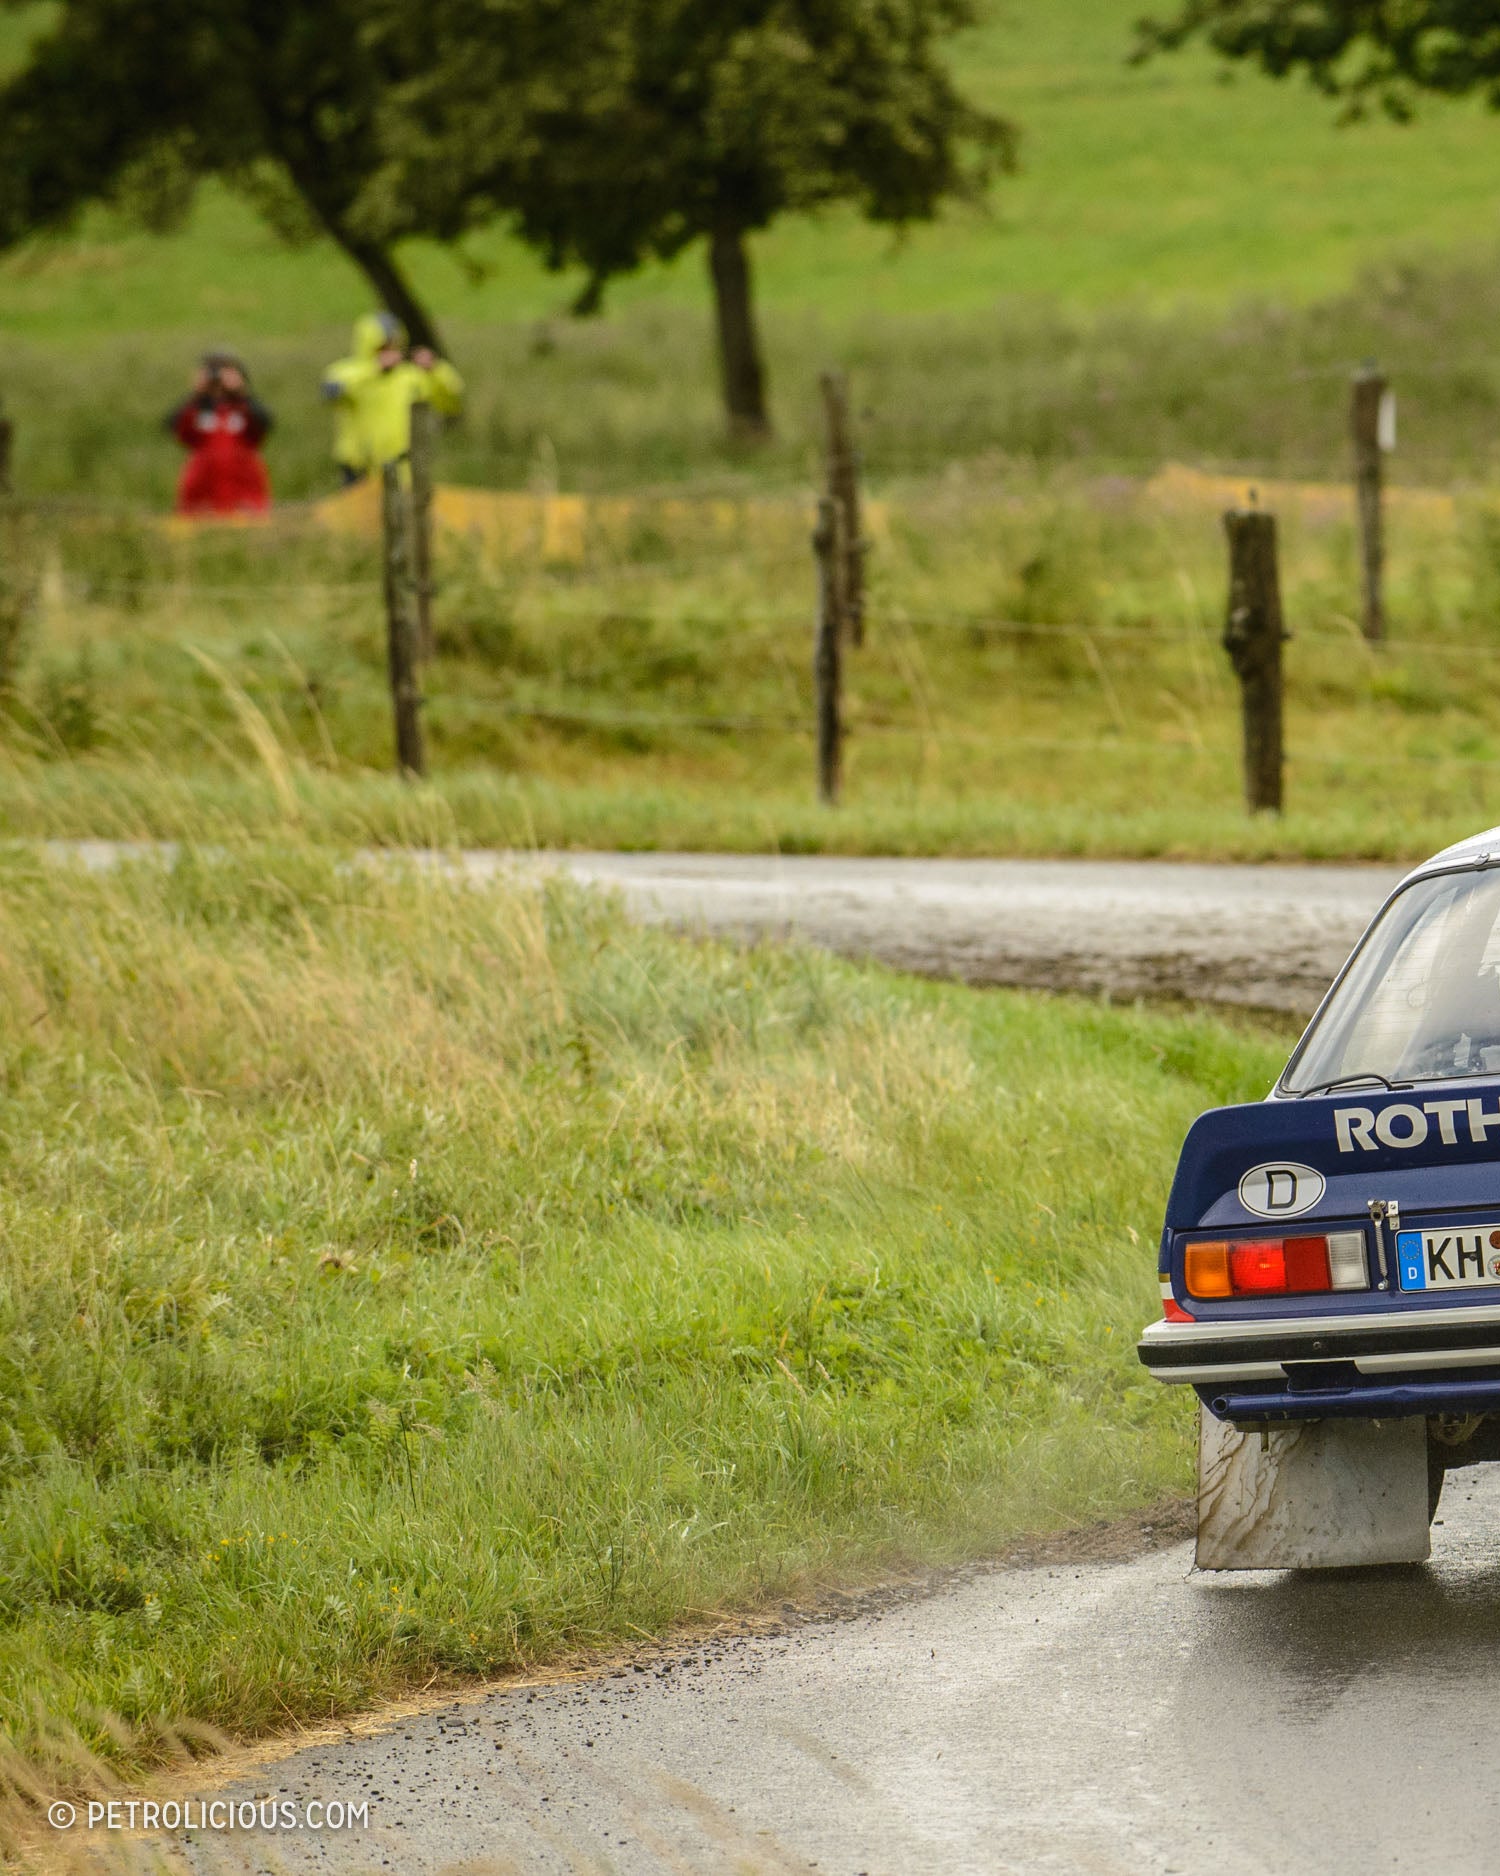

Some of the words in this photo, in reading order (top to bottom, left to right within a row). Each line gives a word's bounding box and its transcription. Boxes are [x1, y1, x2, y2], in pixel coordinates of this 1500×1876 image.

[1266, 1169, 1297, 1210] D
[1407, 1266, 1418, 1280] D
[1426, 1235, 1485, 1281] KH
